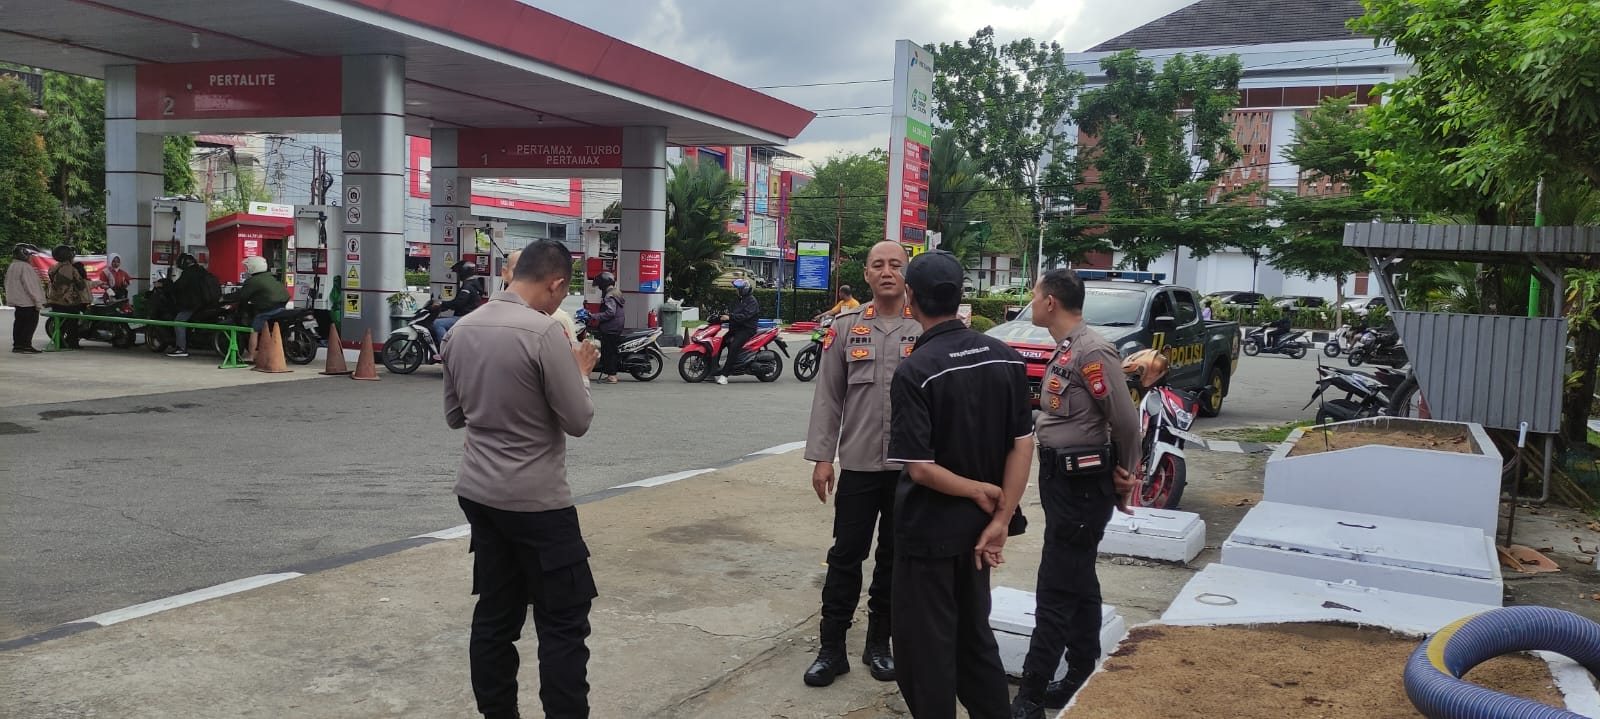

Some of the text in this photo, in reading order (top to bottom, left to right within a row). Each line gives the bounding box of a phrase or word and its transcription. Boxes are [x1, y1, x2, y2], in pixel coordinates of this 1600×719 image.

[209, 73, 276, 87] PERTALITE
[162, 96, 175, 116] 2
[516, 143, 621, 155] PERTAMAX TURBO
[480, 153, 489, 166] 1
[546, 155, 601, 165] PERTAMAX
[1171, 343, 1205, 366] POLISI
